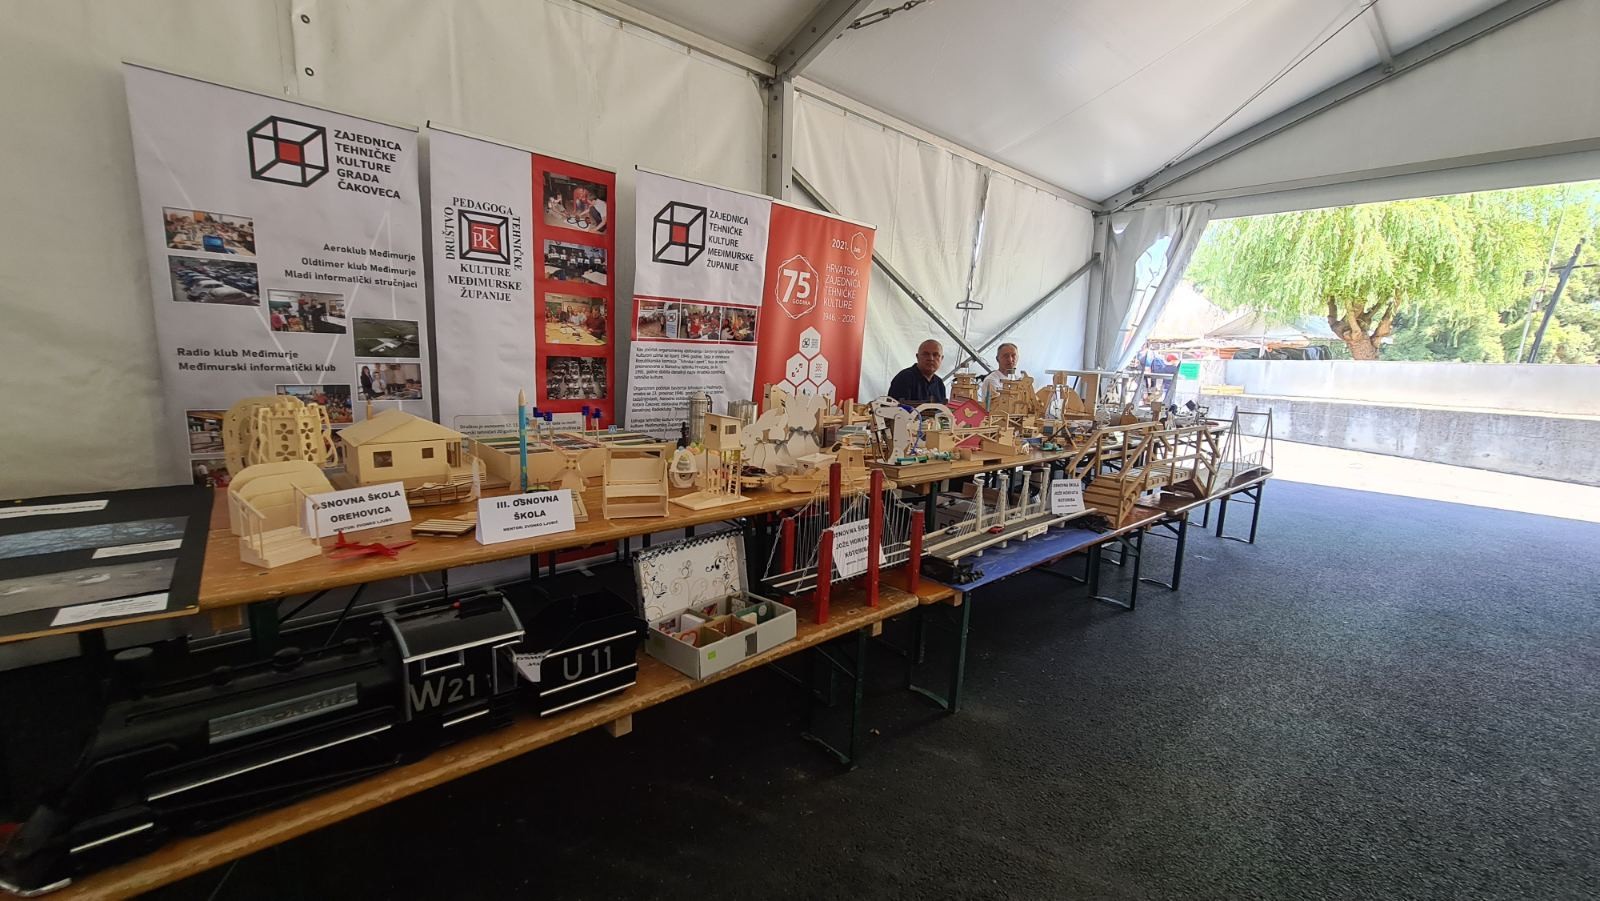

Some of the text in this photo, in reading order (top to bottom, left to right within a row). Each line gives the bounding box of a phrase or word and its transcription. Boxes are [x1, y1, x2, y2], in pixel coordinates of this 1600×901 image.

[334, 130, 402, 152] ZAJEDNICA
[335, 142, 396, 162] TEHNIČKE
[336, 156, 392, 174] KULTURE
[337, 168, 380, 184] GRADA
[338, 180, 401, 200] ČAKOVECA
[452, 197, 513, 216] PEDAGOGA
[710, 210, 749, 226] ZAJEDNICA
[442, 206, 455, 260] DRUŠTVO
[709, 223, 743, 237] TEHNIČKE
[513, 216, 523, 272] TEHNIČKE
[708, 235, 739, 248] KULTURE
[323, 243, 416, 262] Aeroklub Međimurje
[708, 247, 754, 262] MEĐIMURSKE
[301, 257, 416, 277] Oldtimer klub Međimurje
[460, 262, 511, 278] KULTURE
[707, 258, 739, 272] ŽUPANIJE
[826, 264, 859, 276] HRVATSKA
[284, 269, 418, 290] Mladi informatički stručnjaci
[448, 275, 522, 291] MEĐIMURSKE
[782, 269, 810, 303] 75
[826, 275, 861, 288] ZAJEDNICA
[460, 286, 512, 302] ŽUPANIJE
[825, 286, 856, 299] TEHNIČKE
[824, 297, 852, 309] KULTURE
[177, 347, 298, 360] Radio klub Međimurje
[178, 362, 336, 372] Međimurski informatički klub
[368, 490, 401, 502] ŠKOLA
[496, 495, 559, 509] III. OSNOVNA
[330, 506, 391, 523] OREHOVICA
[514, 509, 546, 521] ŠKOLA
[850, 536, 869, 545] HORVA
[564, 653, 582, 680] U
[592, 646, 611, 673] 11
[409, 674, 475, 712] W21
